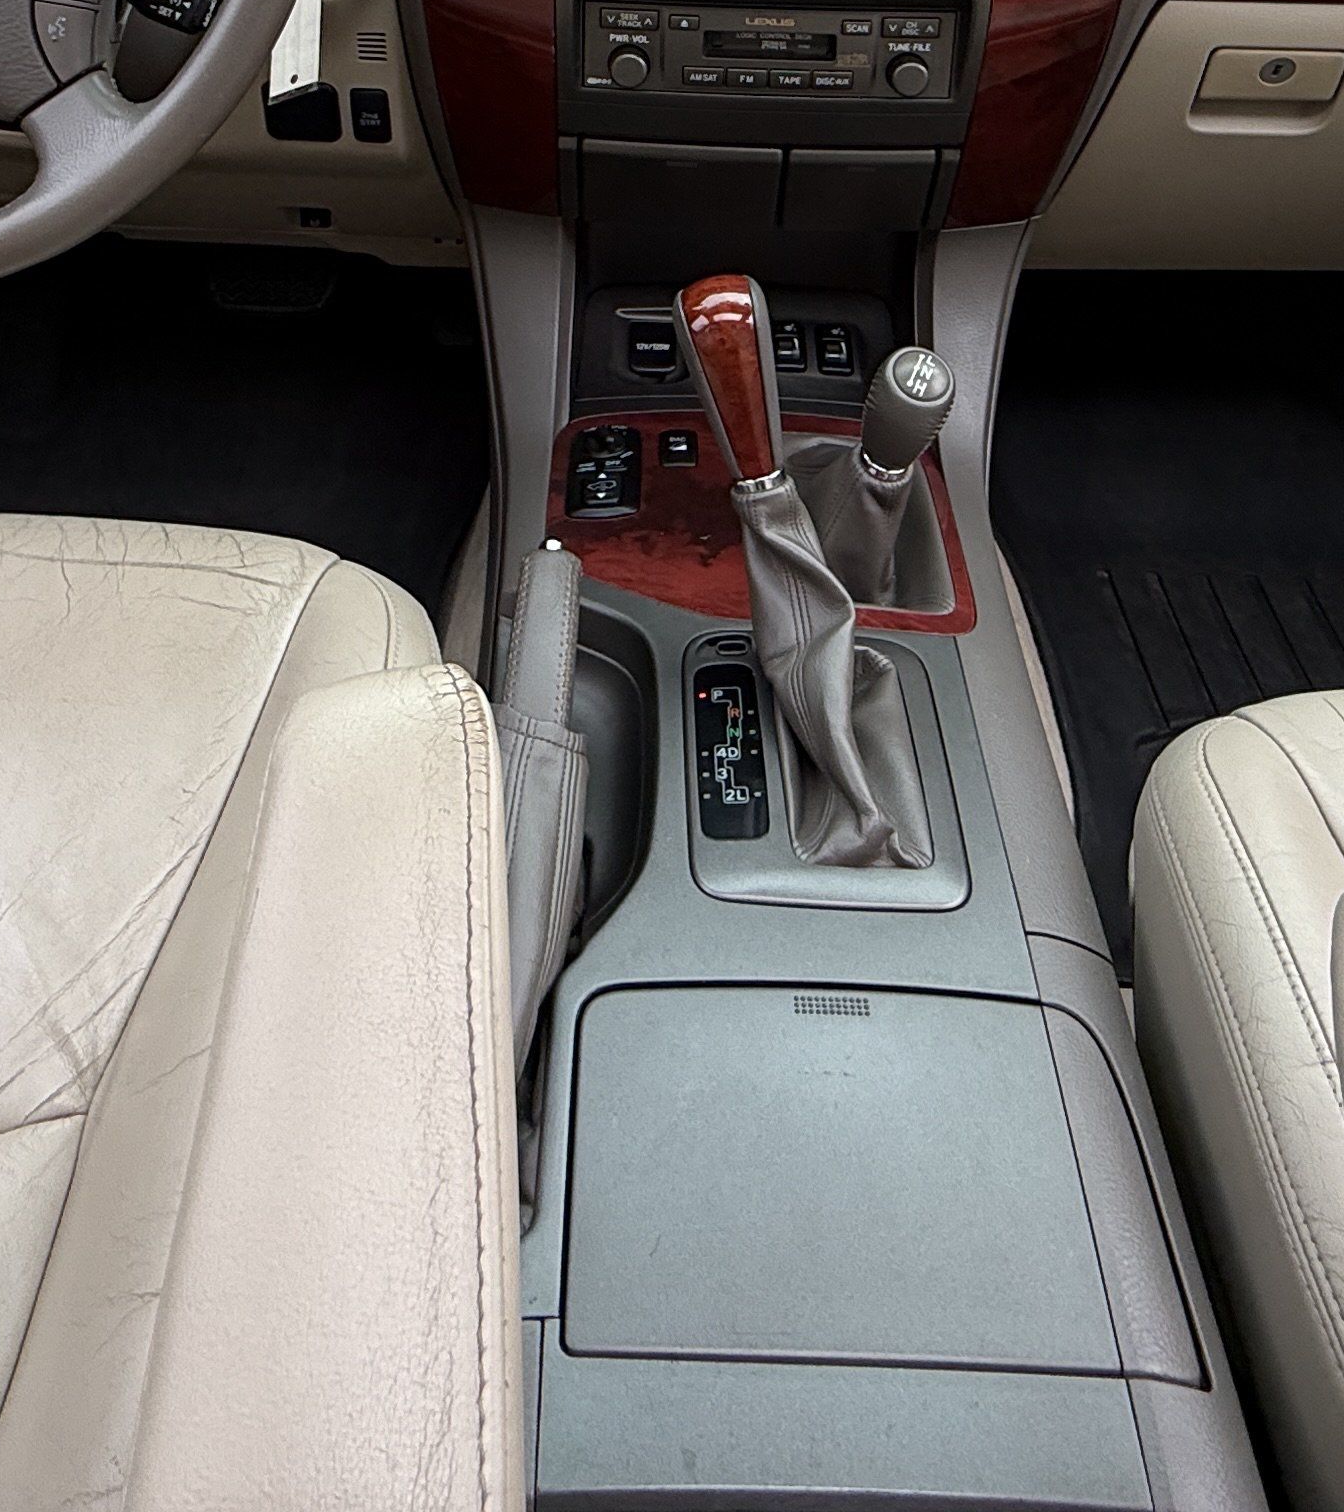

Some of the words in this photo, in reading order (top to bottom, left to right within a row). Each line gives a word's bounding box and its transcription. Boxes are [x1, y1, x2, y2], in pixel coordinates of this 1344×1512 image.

[617, 19, 642, 28] TRACK
[745, 16, 796, 28] LEXUS
[845, 24, 870, 34] SCAN
[739, 74, 754, 83] FM
[778, 76, 801, 85] TAPE
[927, 355, 936, 368] L
[920, 365, 934, 381] N
[911, 379, 928, 397] H
[712, 689, 723, 701] P
[730, 707, 740, 718] R
[729, 727, 740, 737] N
[716, 768, 728, 780] 3
